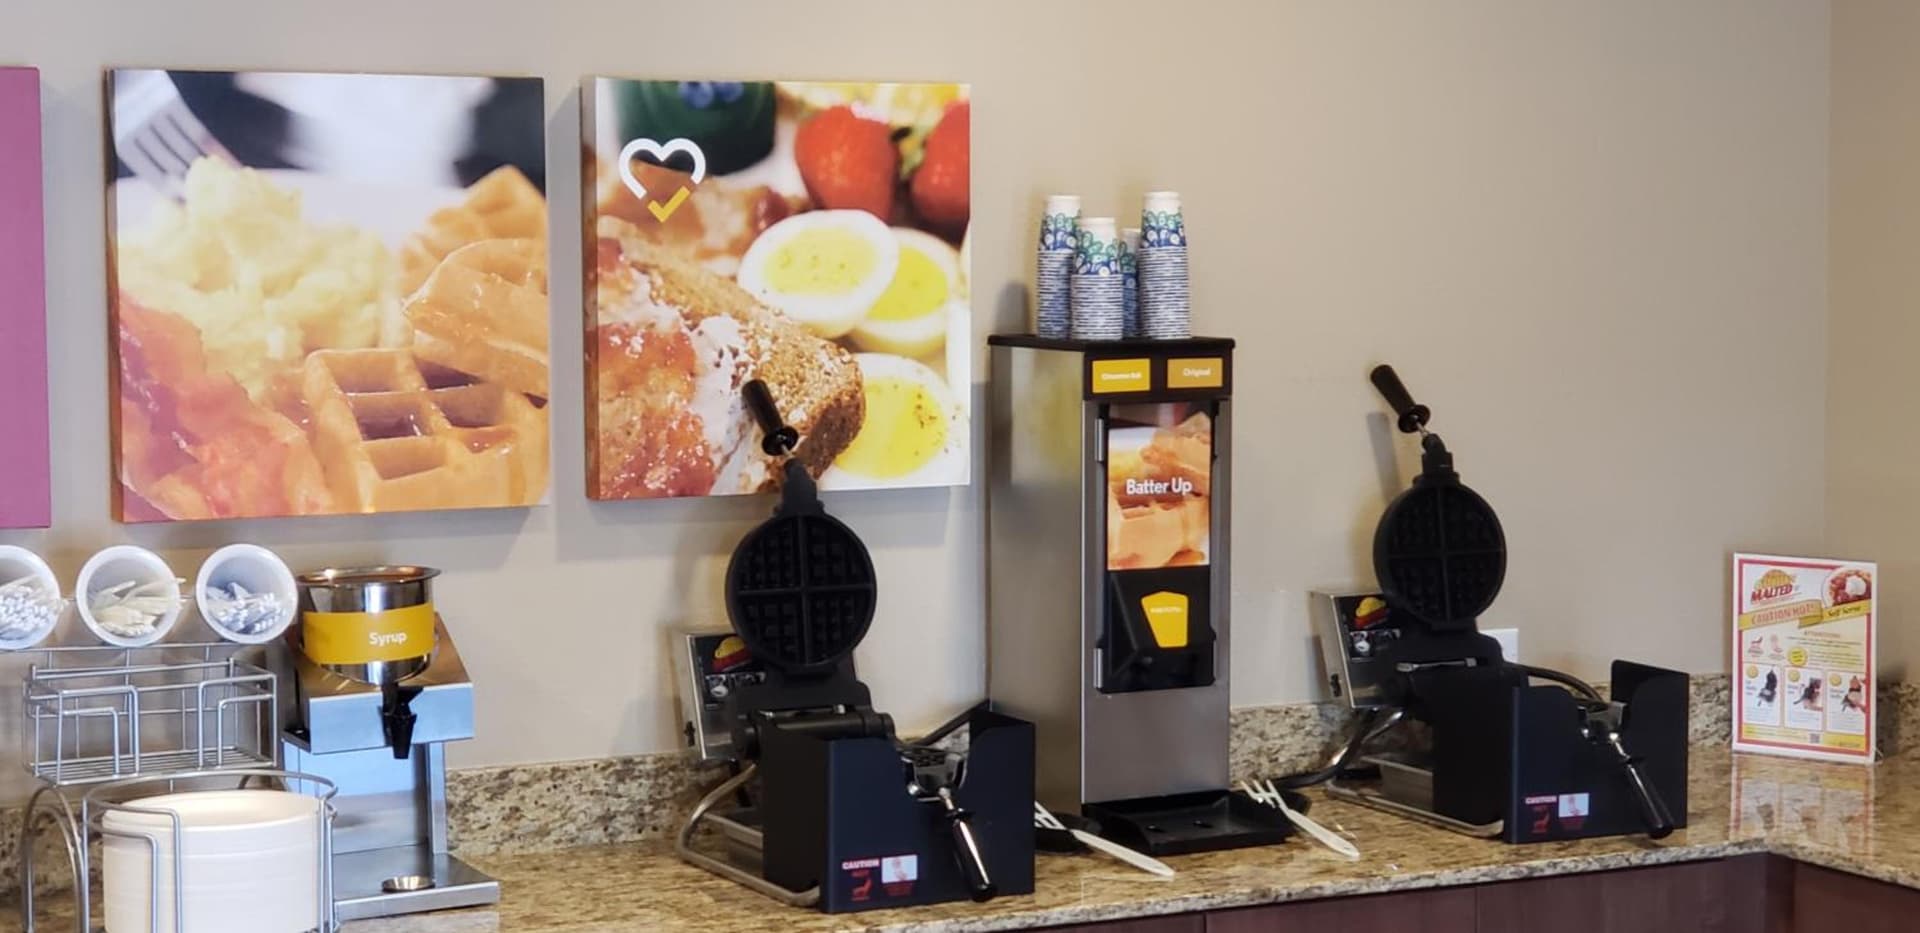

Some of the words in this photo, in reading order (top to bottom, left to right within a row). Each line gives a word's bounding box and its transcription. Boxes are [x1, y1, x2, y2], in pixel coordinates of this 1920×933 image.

[1126, 478, 1169, 495] Batter
[1171, 477, 1193, 494] Up
[1750, 584, 1793, 601] MALTED
[1751, 605, 1791, 624] CAUTION
[369, 632, 408, 646] Syrup
